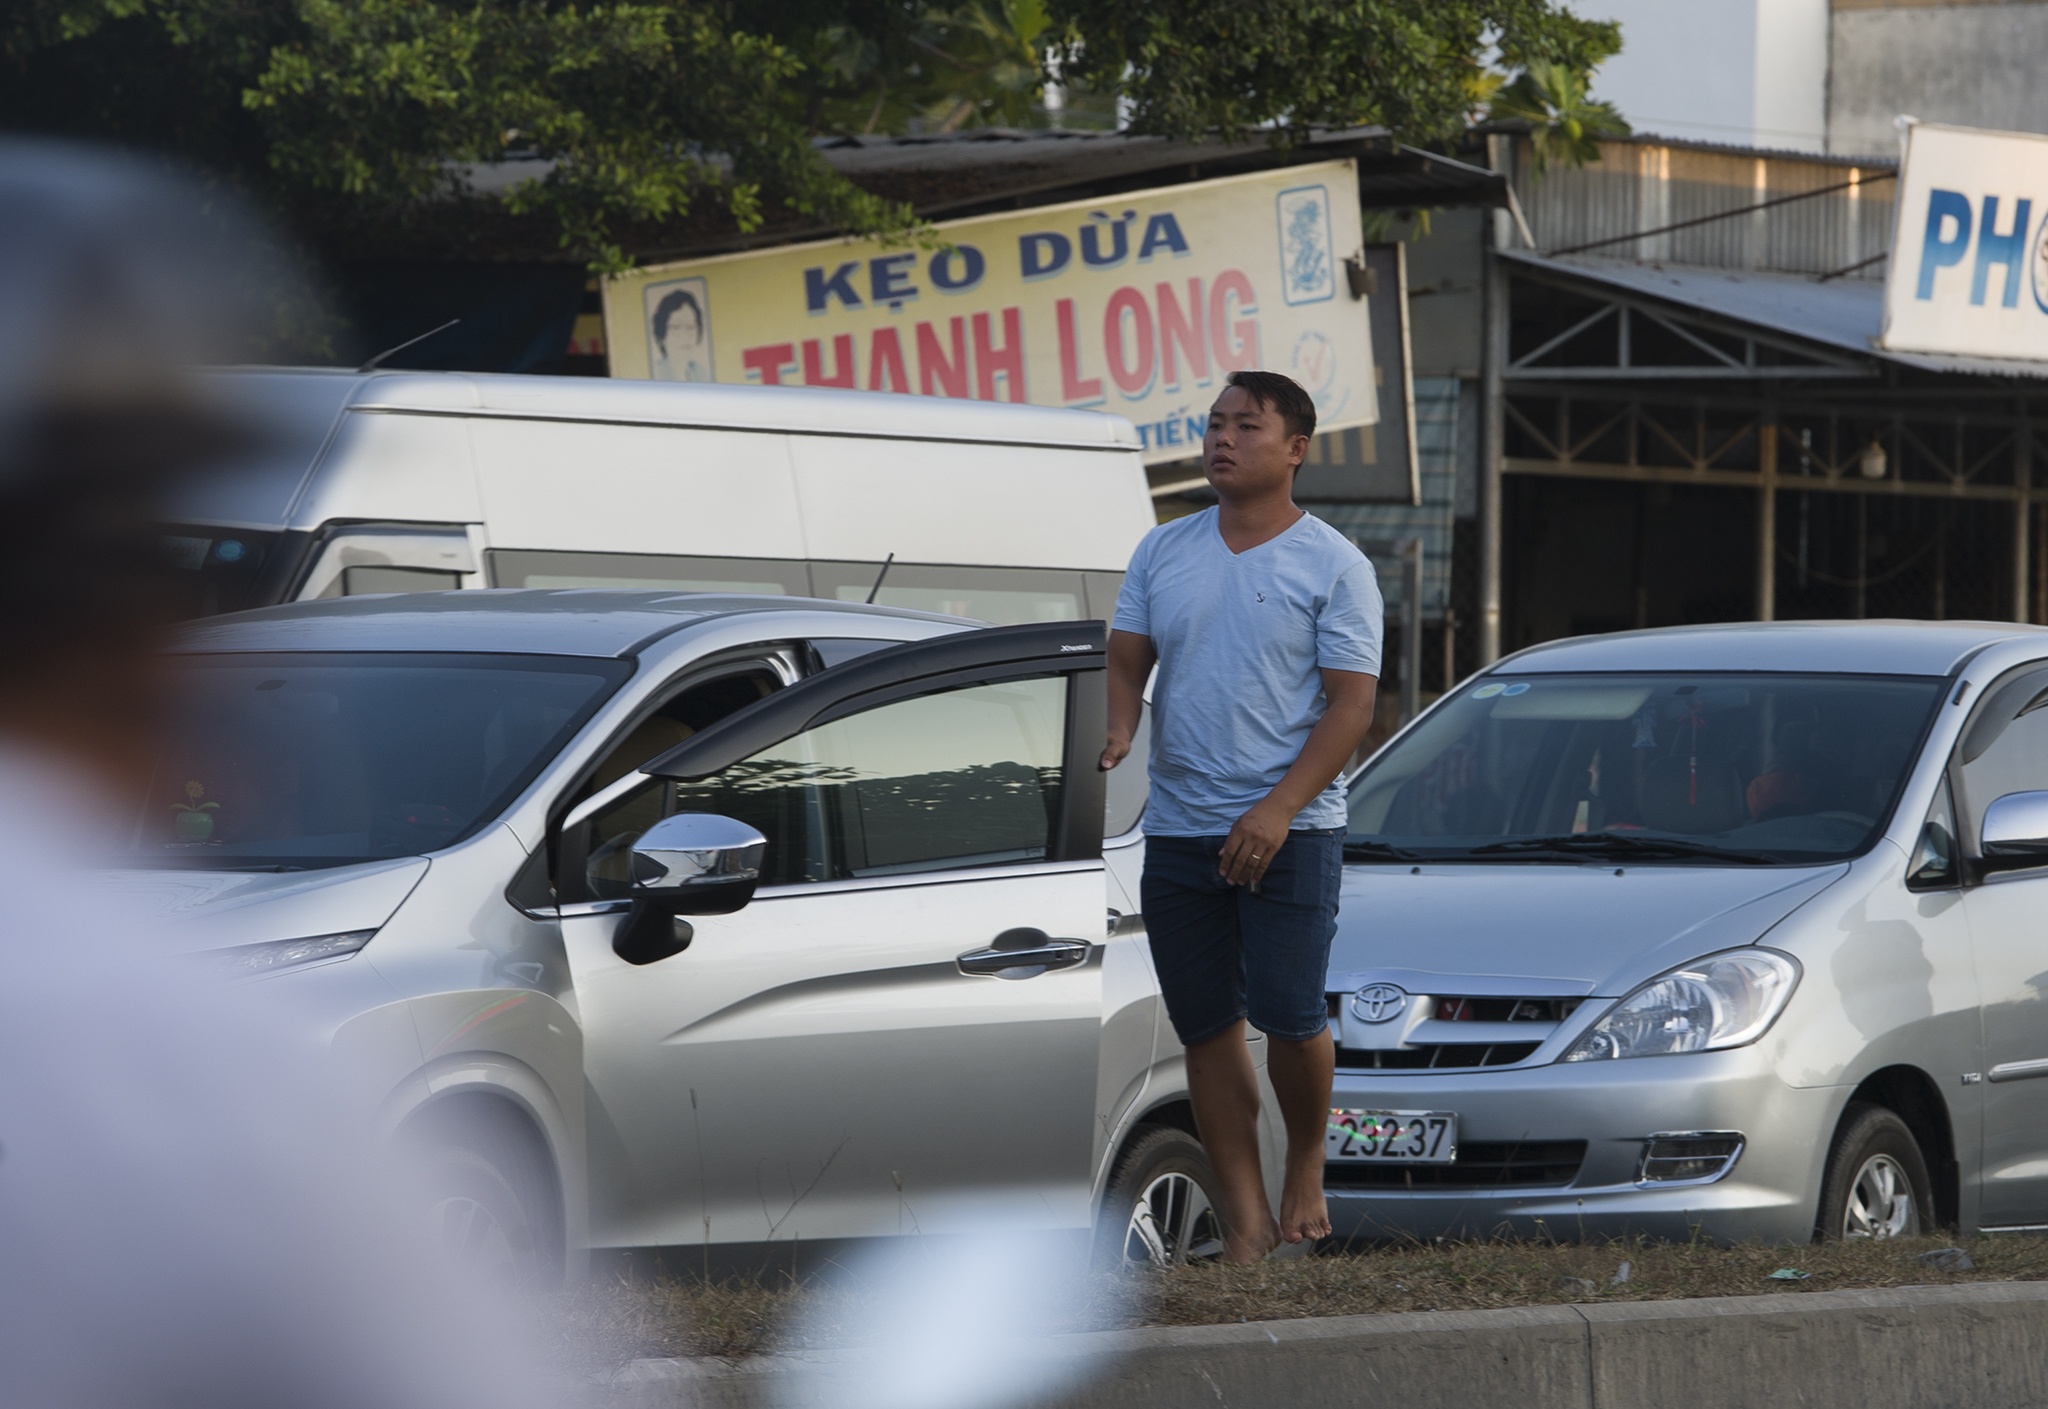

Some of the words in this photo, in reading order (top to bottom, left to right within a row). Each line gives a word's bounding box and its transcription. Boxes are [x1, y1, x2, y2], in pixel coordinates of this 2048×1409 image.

[804, 244, 987, 313] KẸO
[1018, 210, 1190, 281] DỪA
[1056, 269, 1259, 406] LONG
